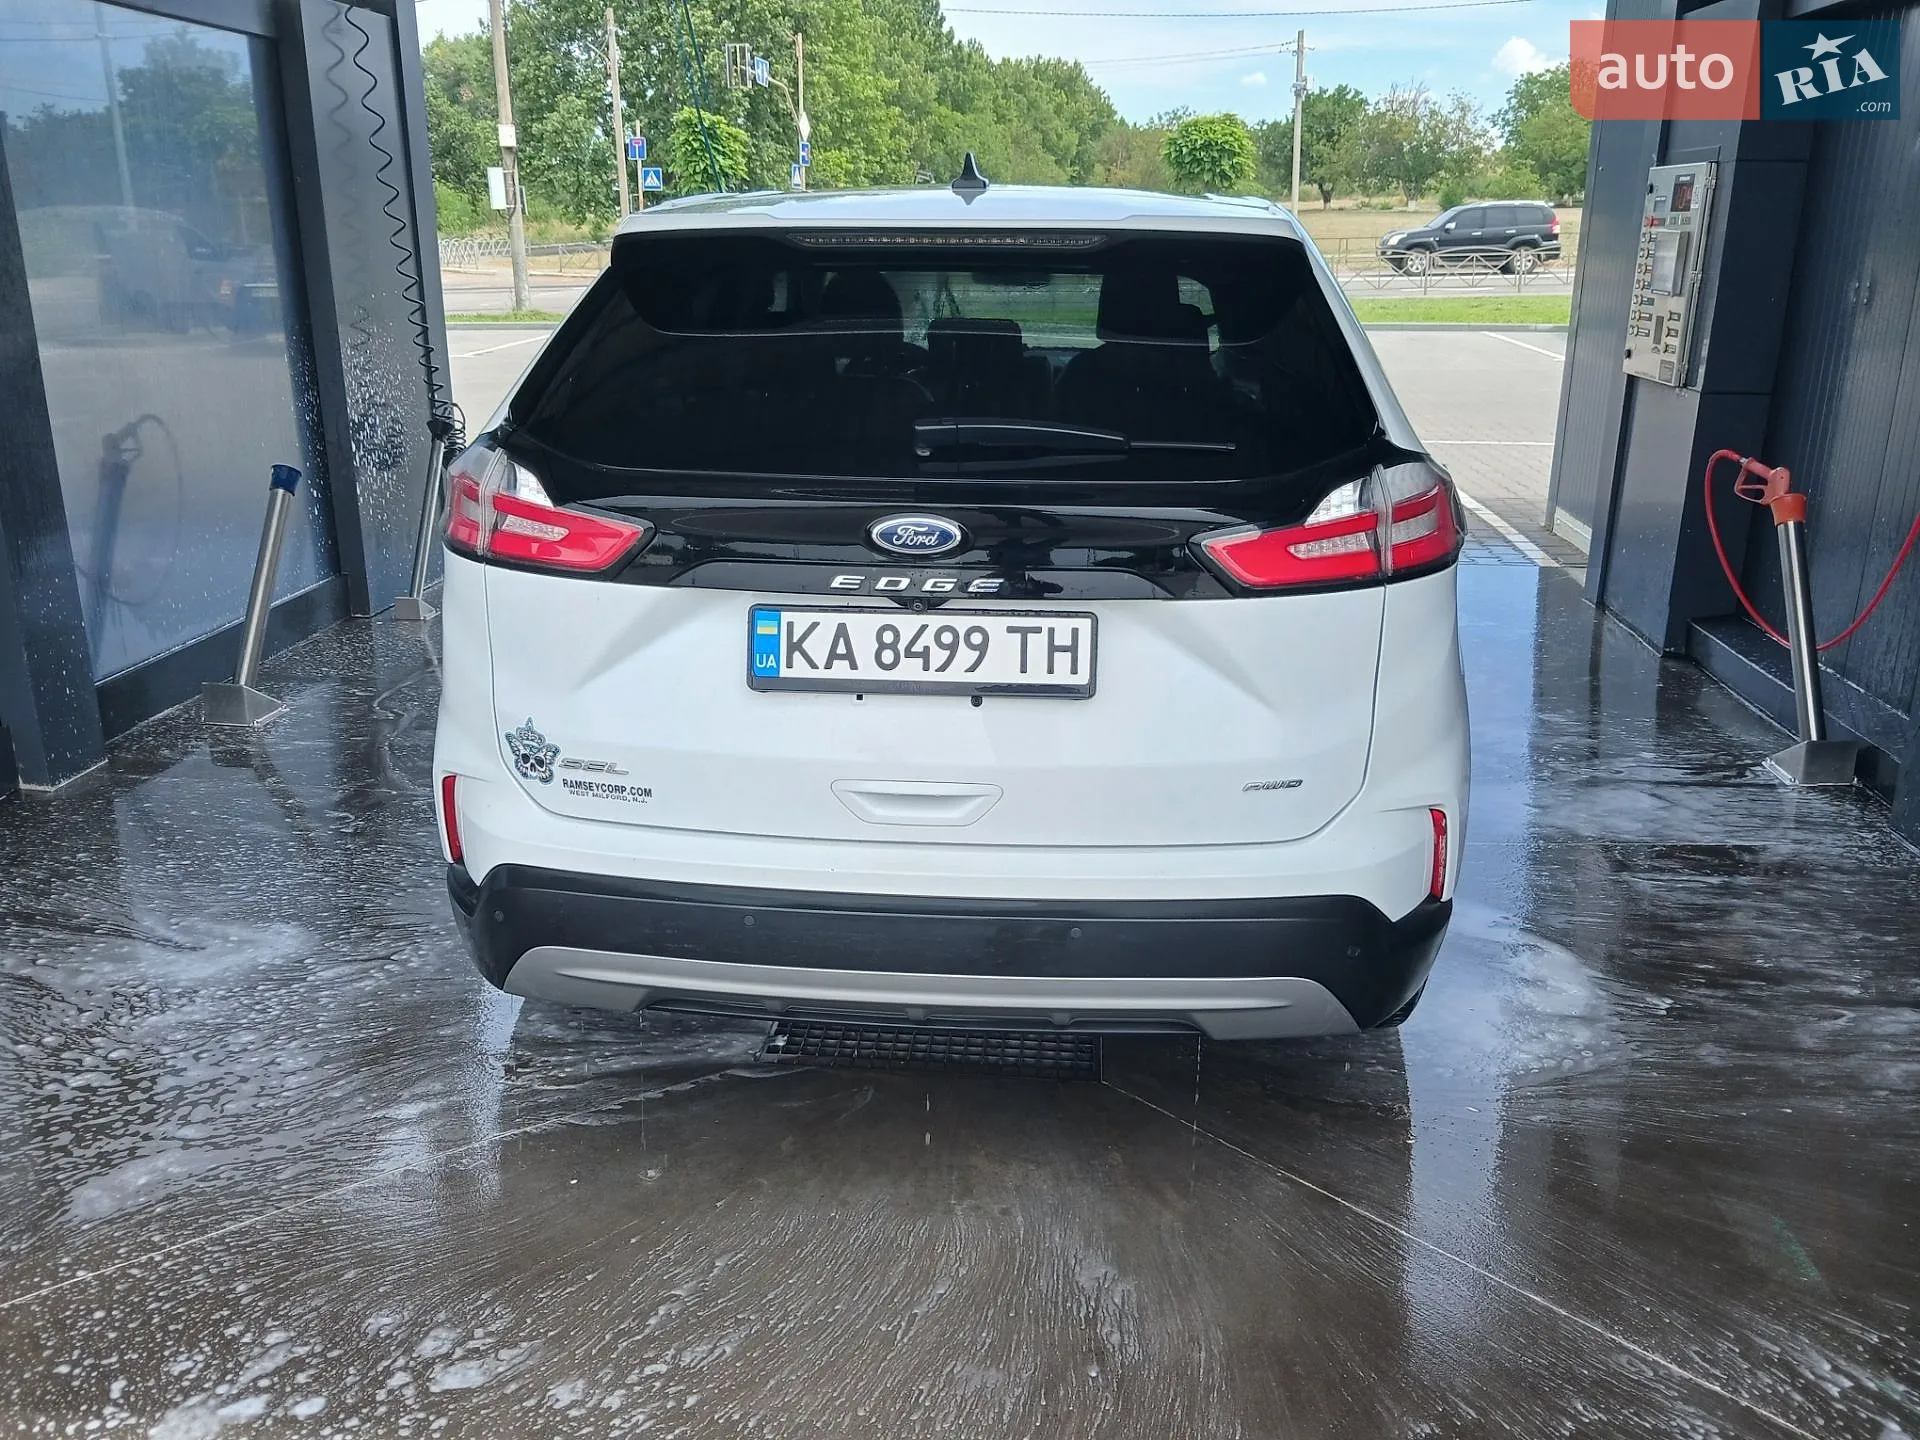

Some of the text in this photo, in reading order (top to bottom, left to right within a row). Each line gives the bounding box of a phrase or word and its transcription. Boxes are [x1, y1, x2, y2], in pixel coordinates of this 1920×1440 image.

[893, 525, 939, 547] Ford
[830, 575, 1004, 593] EDGE
[786, 621, 1079, 675] KA 8499 TH
[756, 653, 777, 669] UA
[558, 757, 630, 776] SEL
[562, 778, 653, 798] RAMSEYCORP.COM
[568, 789, 648, 804] WEST MILFORD, N.J.
